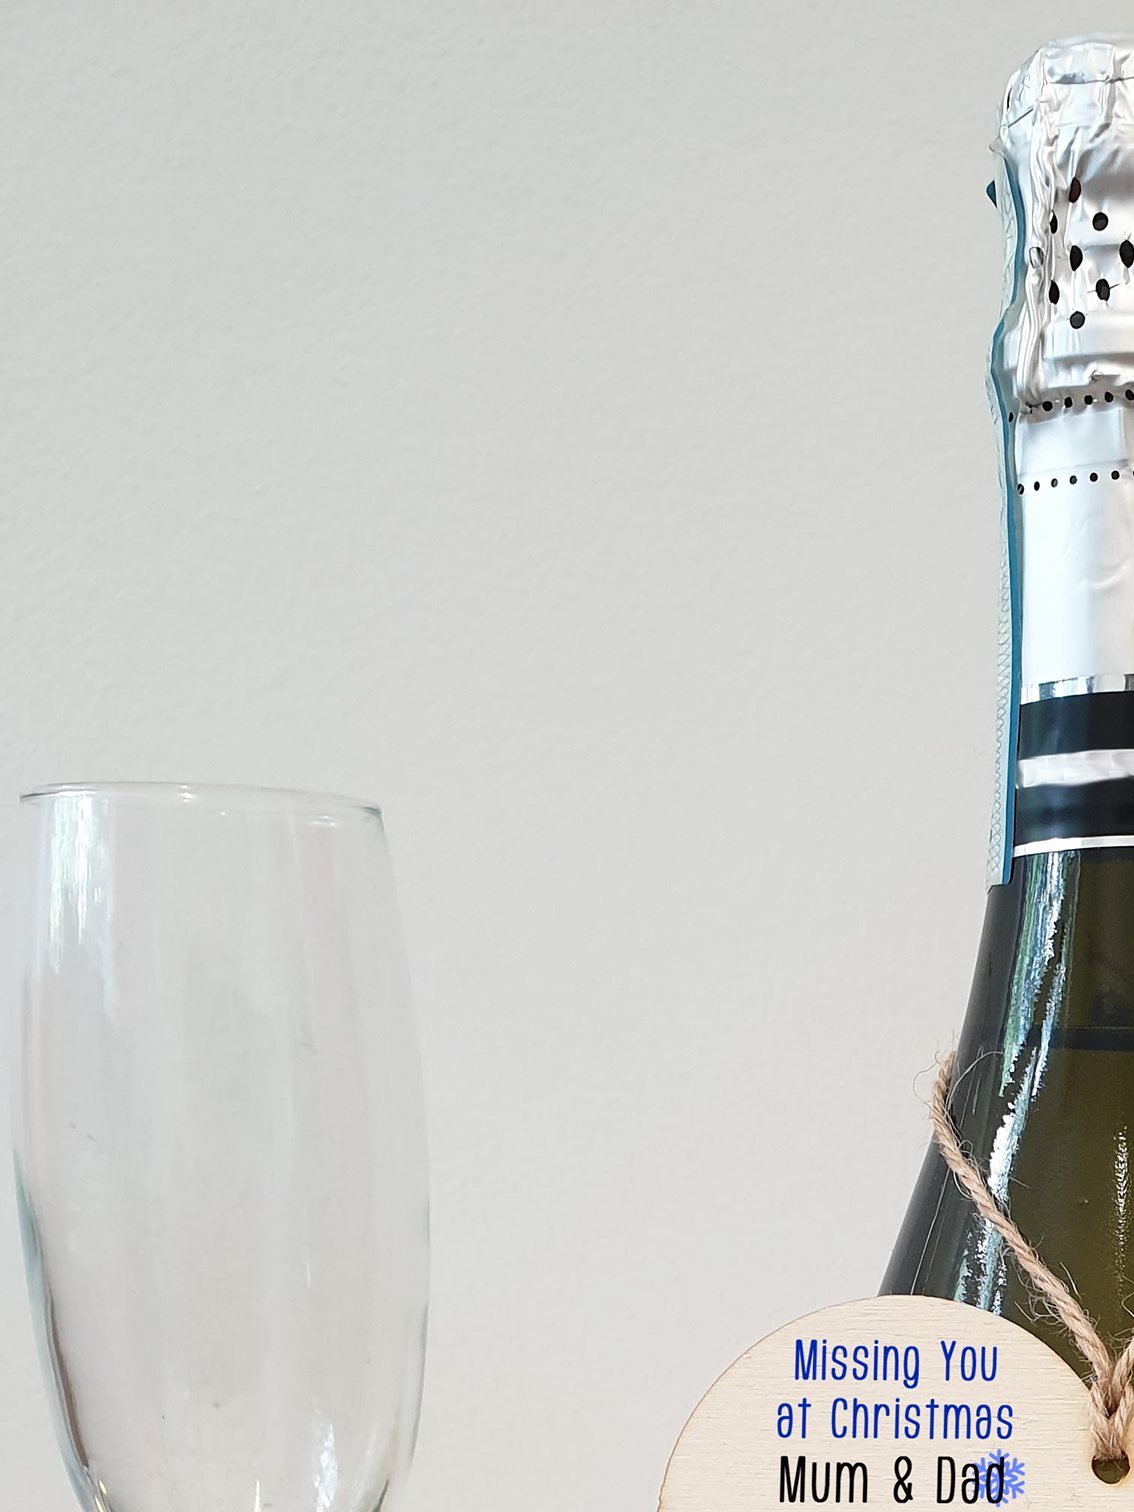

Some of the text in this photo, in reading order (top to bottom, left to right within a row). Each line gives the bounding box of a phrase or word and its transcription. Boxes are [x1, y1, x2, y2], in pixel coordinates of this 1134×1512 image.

[795, 1339, 998, 1389] Missing You
[777, 1397, 1013, 1440] at Christmas
[779, 1455, 1005, 1505] Mum & Dad
